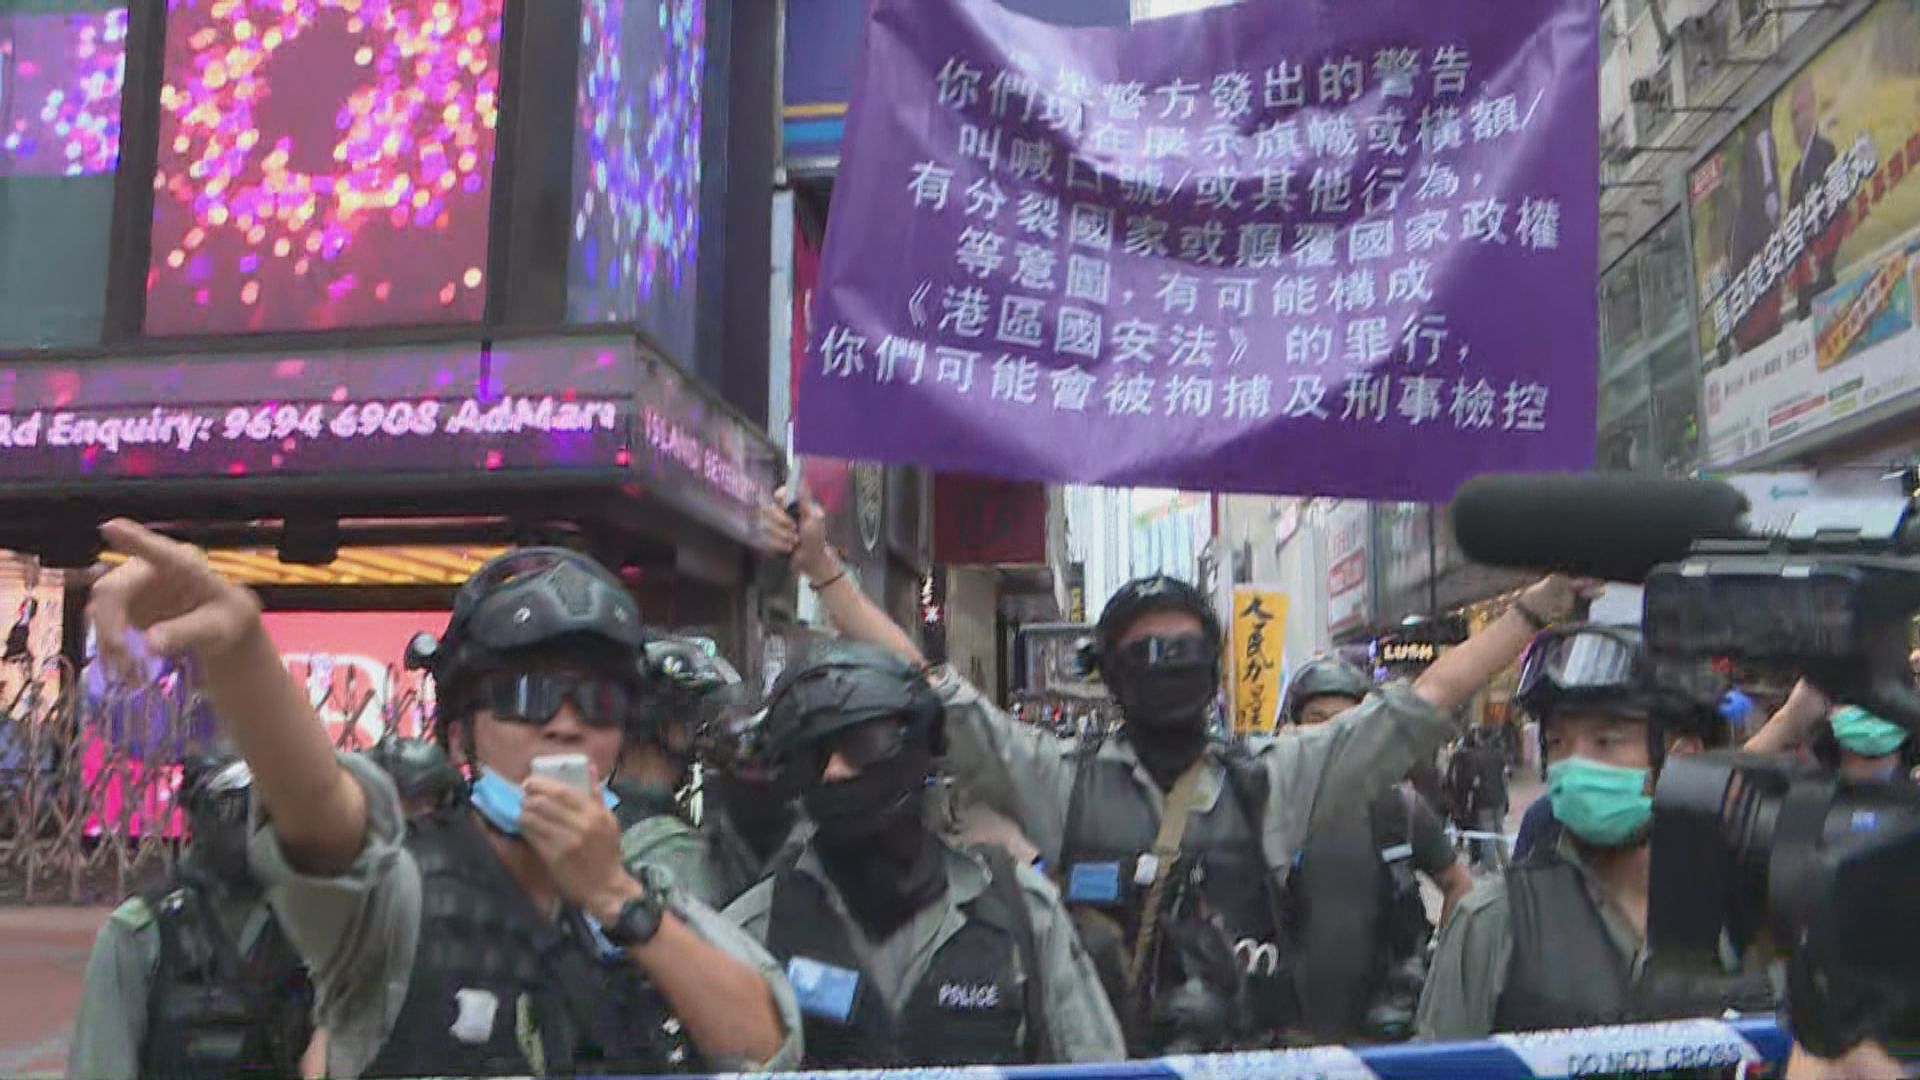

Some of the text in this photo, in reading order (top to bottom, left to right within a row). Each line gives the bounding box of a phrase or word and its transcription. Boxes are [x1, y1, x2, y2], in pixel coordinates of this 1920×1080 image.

[820, 326, 1549, 431] 你們可能會被拘捕及刑事檢控
[223, 407, 322, 440] 9694
[938, 983, 999, 1009] POLICE
[1664, 1043, 1742, 1068] CROSS
